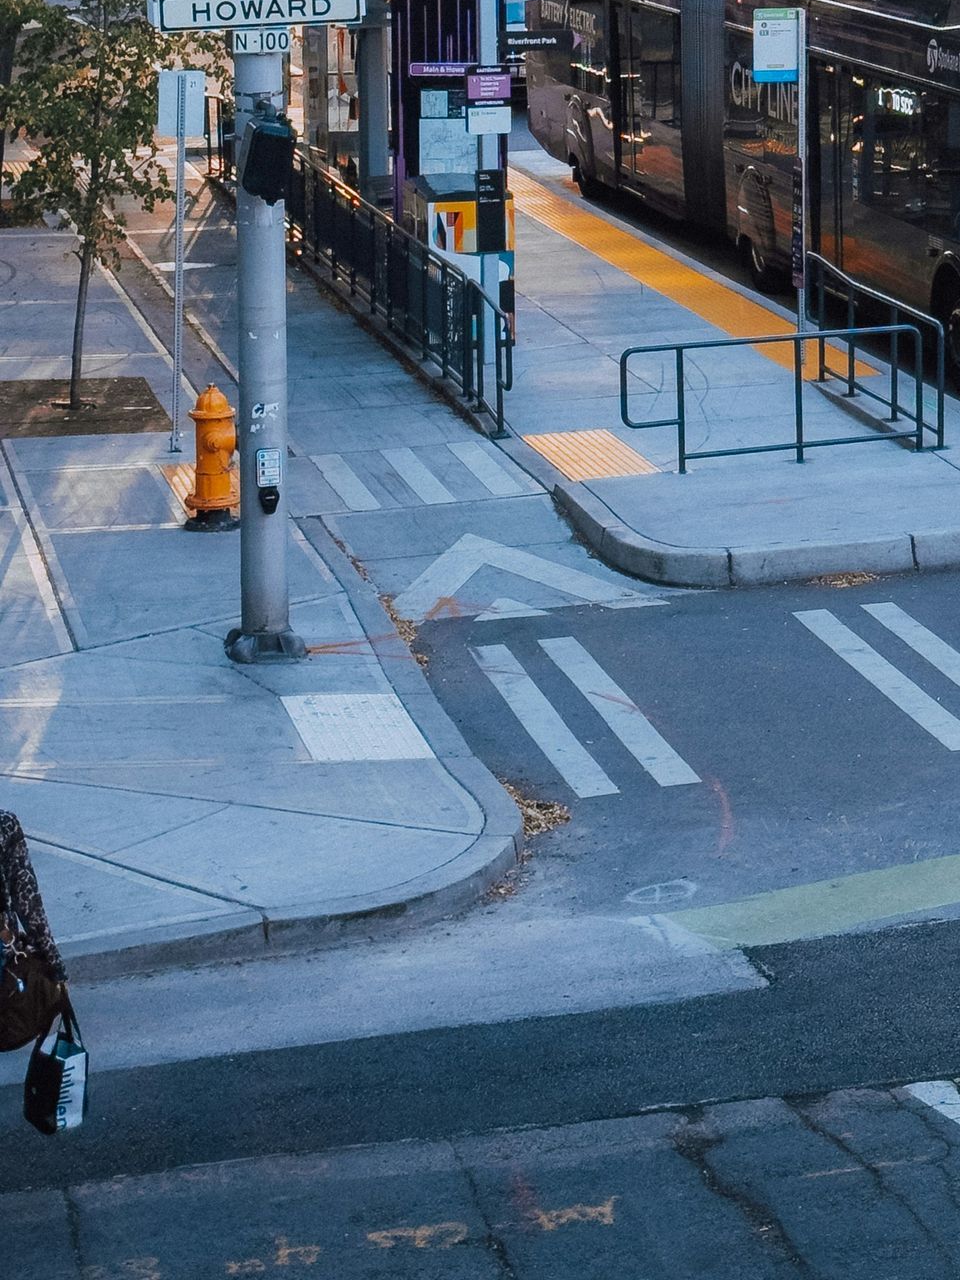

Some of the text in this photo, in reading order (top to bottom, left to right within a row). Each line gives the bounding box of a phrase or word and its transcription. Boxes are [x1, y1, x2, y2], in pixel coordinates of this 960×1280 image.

[540, 0, 596, 35] BATTERY ELECTRIC
[235, 33, 247, 50] N
[507, 37, 557, 45] Riverfront Park
[423, 66, 439, 74] Main
[446, 65, 466, 74] Howa
